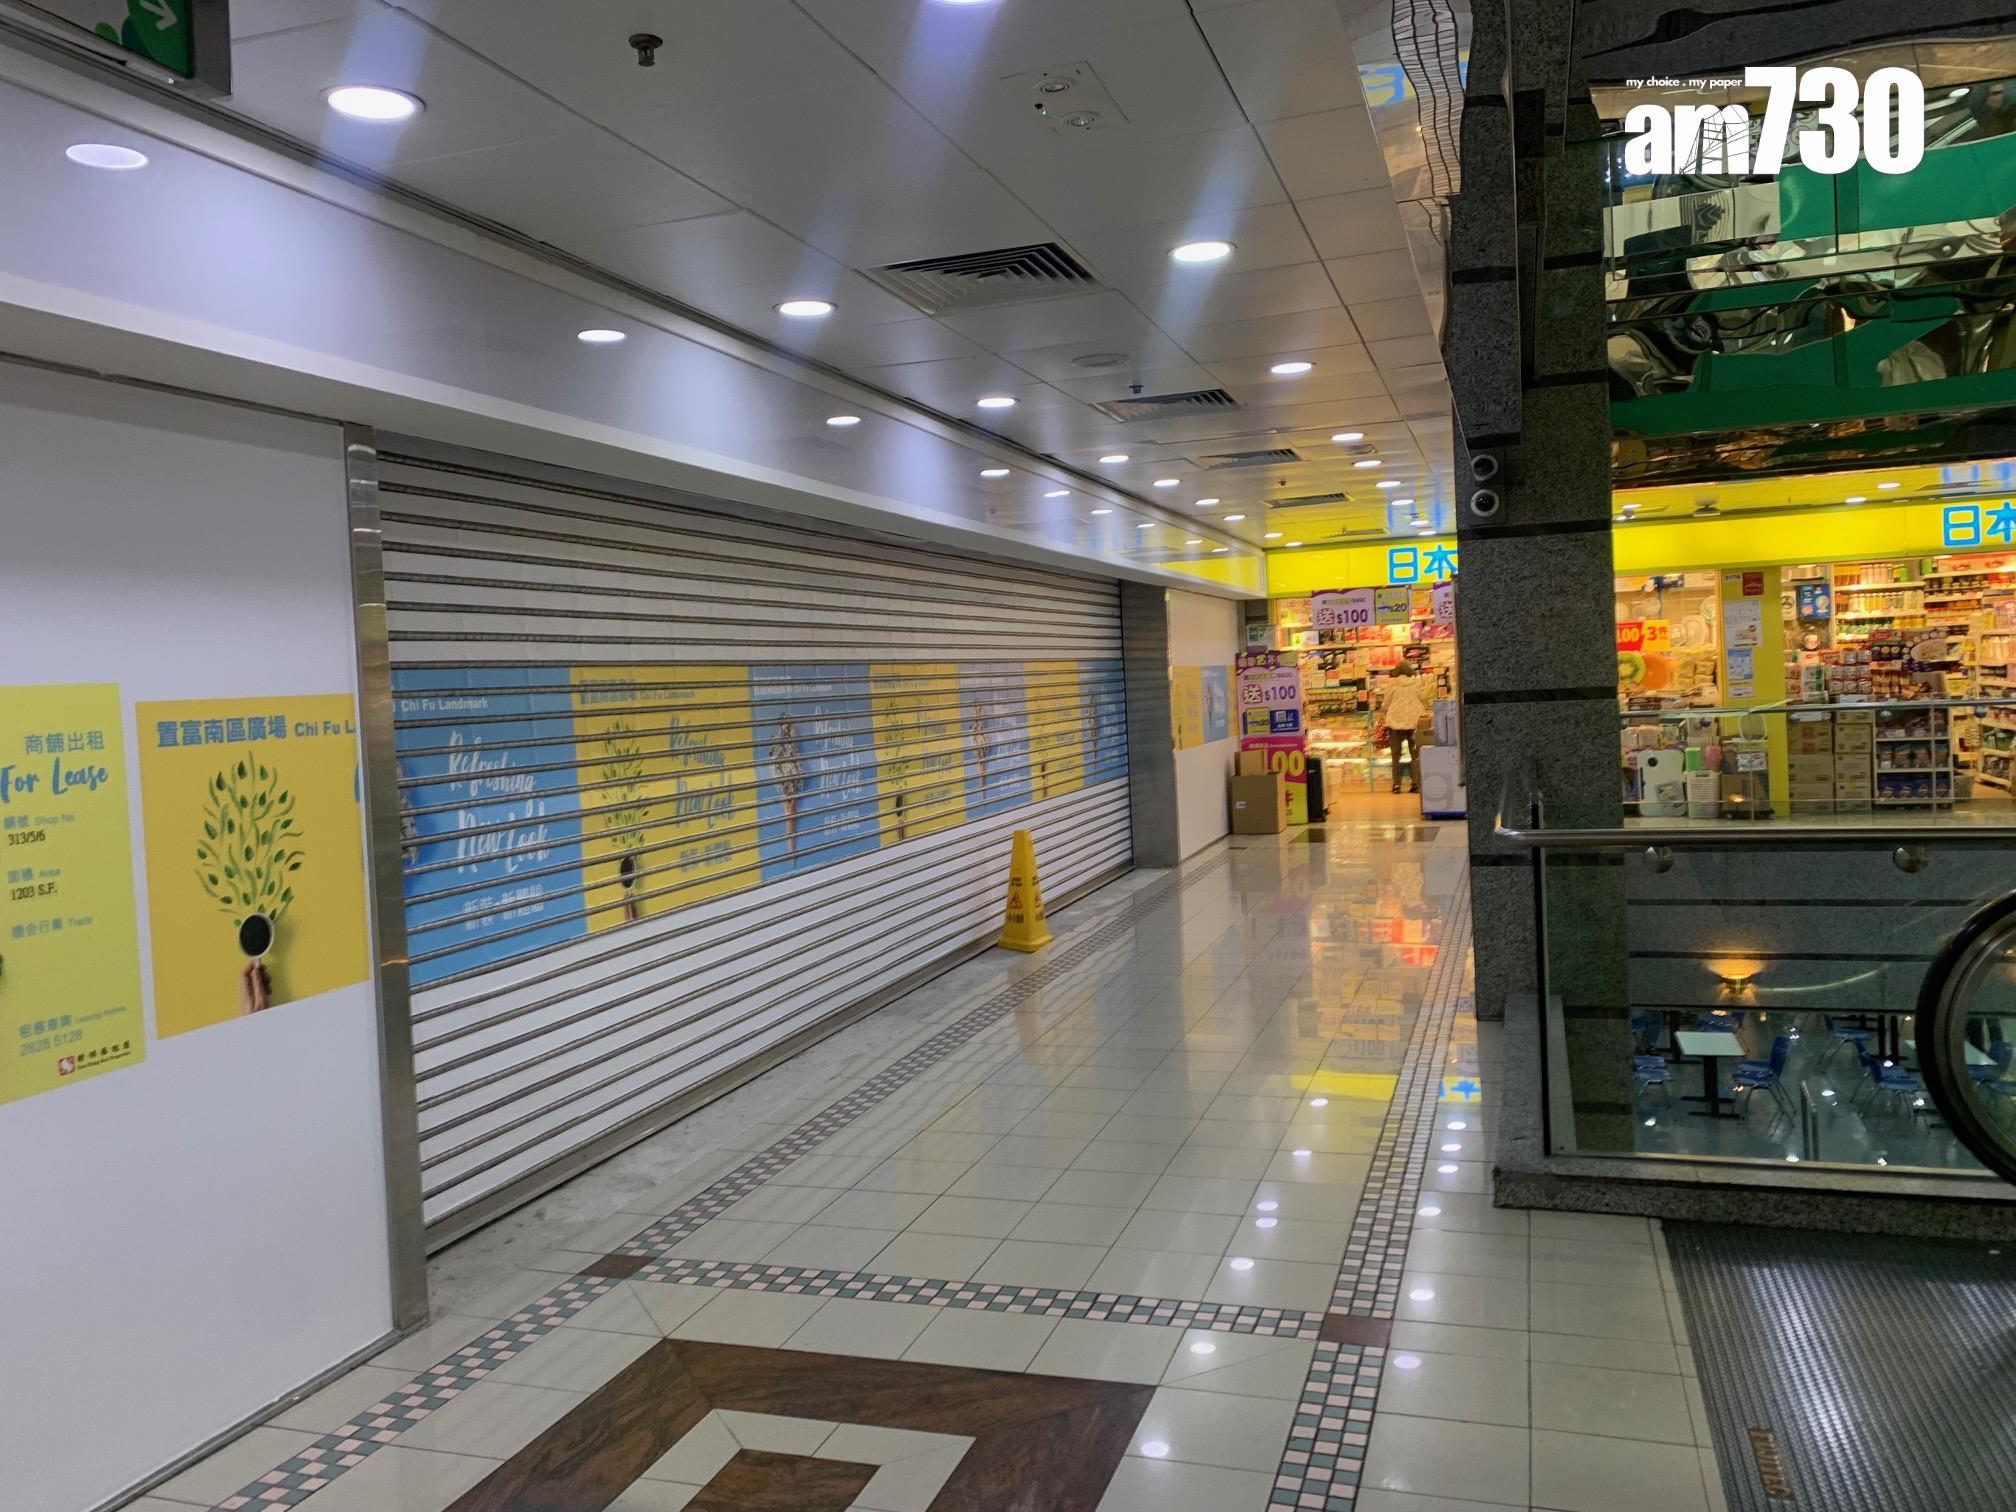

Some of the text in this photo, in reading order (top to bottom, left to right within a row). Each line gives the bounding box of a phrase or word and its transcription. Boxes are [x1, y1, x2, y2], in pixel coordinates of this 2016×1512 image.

[1942, 500, 2016, 547] 日本
[1387, 544, 1458, 584] 日本
[1336, 608, 1369, 624] $100
[401, 699, 420, 712] Chi
[422, 699, 436, 711] Fu
[438, 697, 489, 710] Landmark
[1264, 684, 1297, 701] $100
[156, 715, 357, 747] 置富南區廣場 Chi Fu L
[0, 756, 109, 805] For Lease
